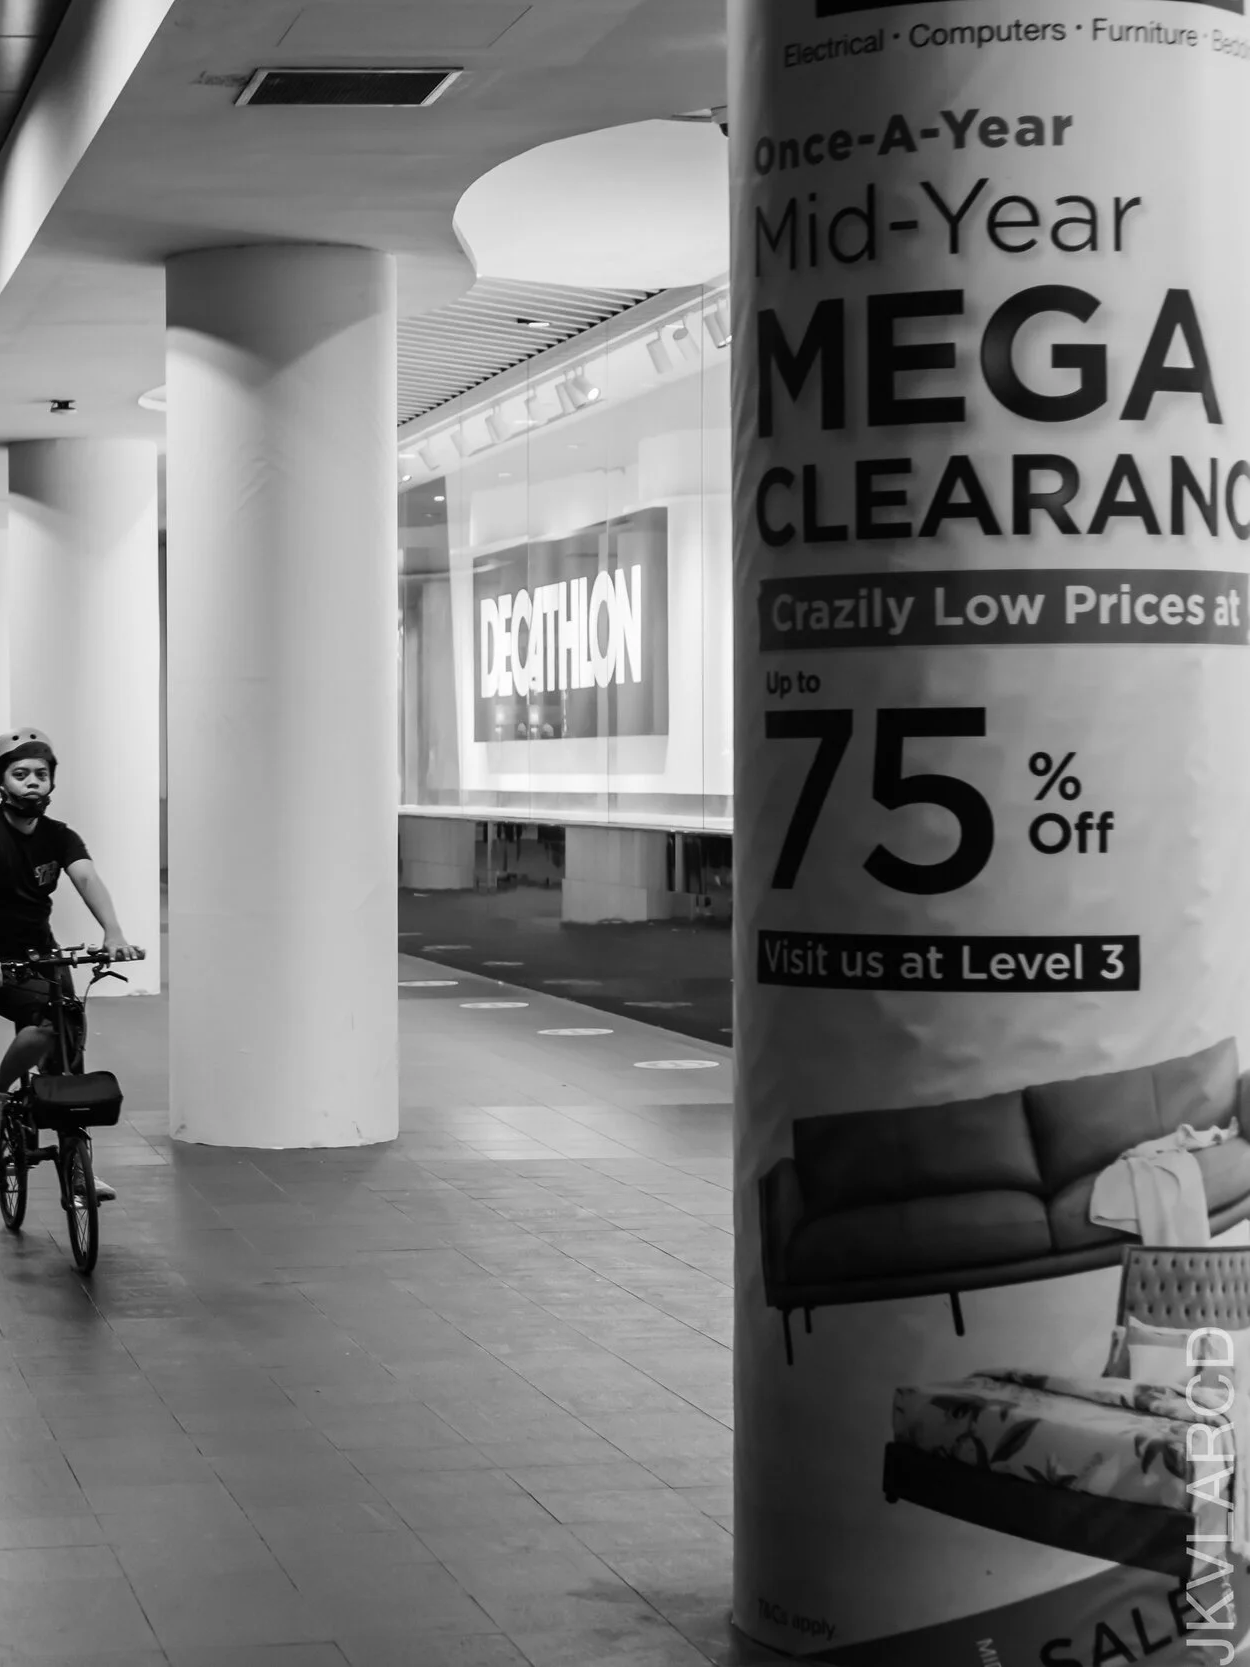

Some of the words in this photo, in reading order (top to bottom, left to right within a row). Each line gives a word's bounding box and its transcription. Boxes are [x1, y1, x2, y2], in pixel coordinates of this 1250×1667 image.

[784, 29, 884, 68] Electrical
[908, 18, 1066, 49] Computers
[1092, 17, 1199, 47] Furniture
[755, 108, 1073, 176] Once-A-Year
[755, 177, 1142, 277] Mid-Year
[757, 284, 1224, 438] MEGA
[480, 564, 642, 699] DECATHLON
[771, 587, 915, 635] Crazily
[934, 587, 1046, 626] Low
[1065, 584, 1205, 626] Prices
[1214, 589, 1241, 627] at
[766, 671, 792, 699] Up
[798, 670, 820, 693] to
[765, 706, 995, 896] 75
[1028, 811, 1115, 855] Off
[764, 938, 828, 976] Visit
[841, 951, 884, 979] us
[900, 946, 944, 979] at
[962, 943, 1083, 981] Level
[1100, 944, 1125, 981] 3
[791, 1613, 837, 1642] apply
[1039, 1584, 1206, 1667] SALE
